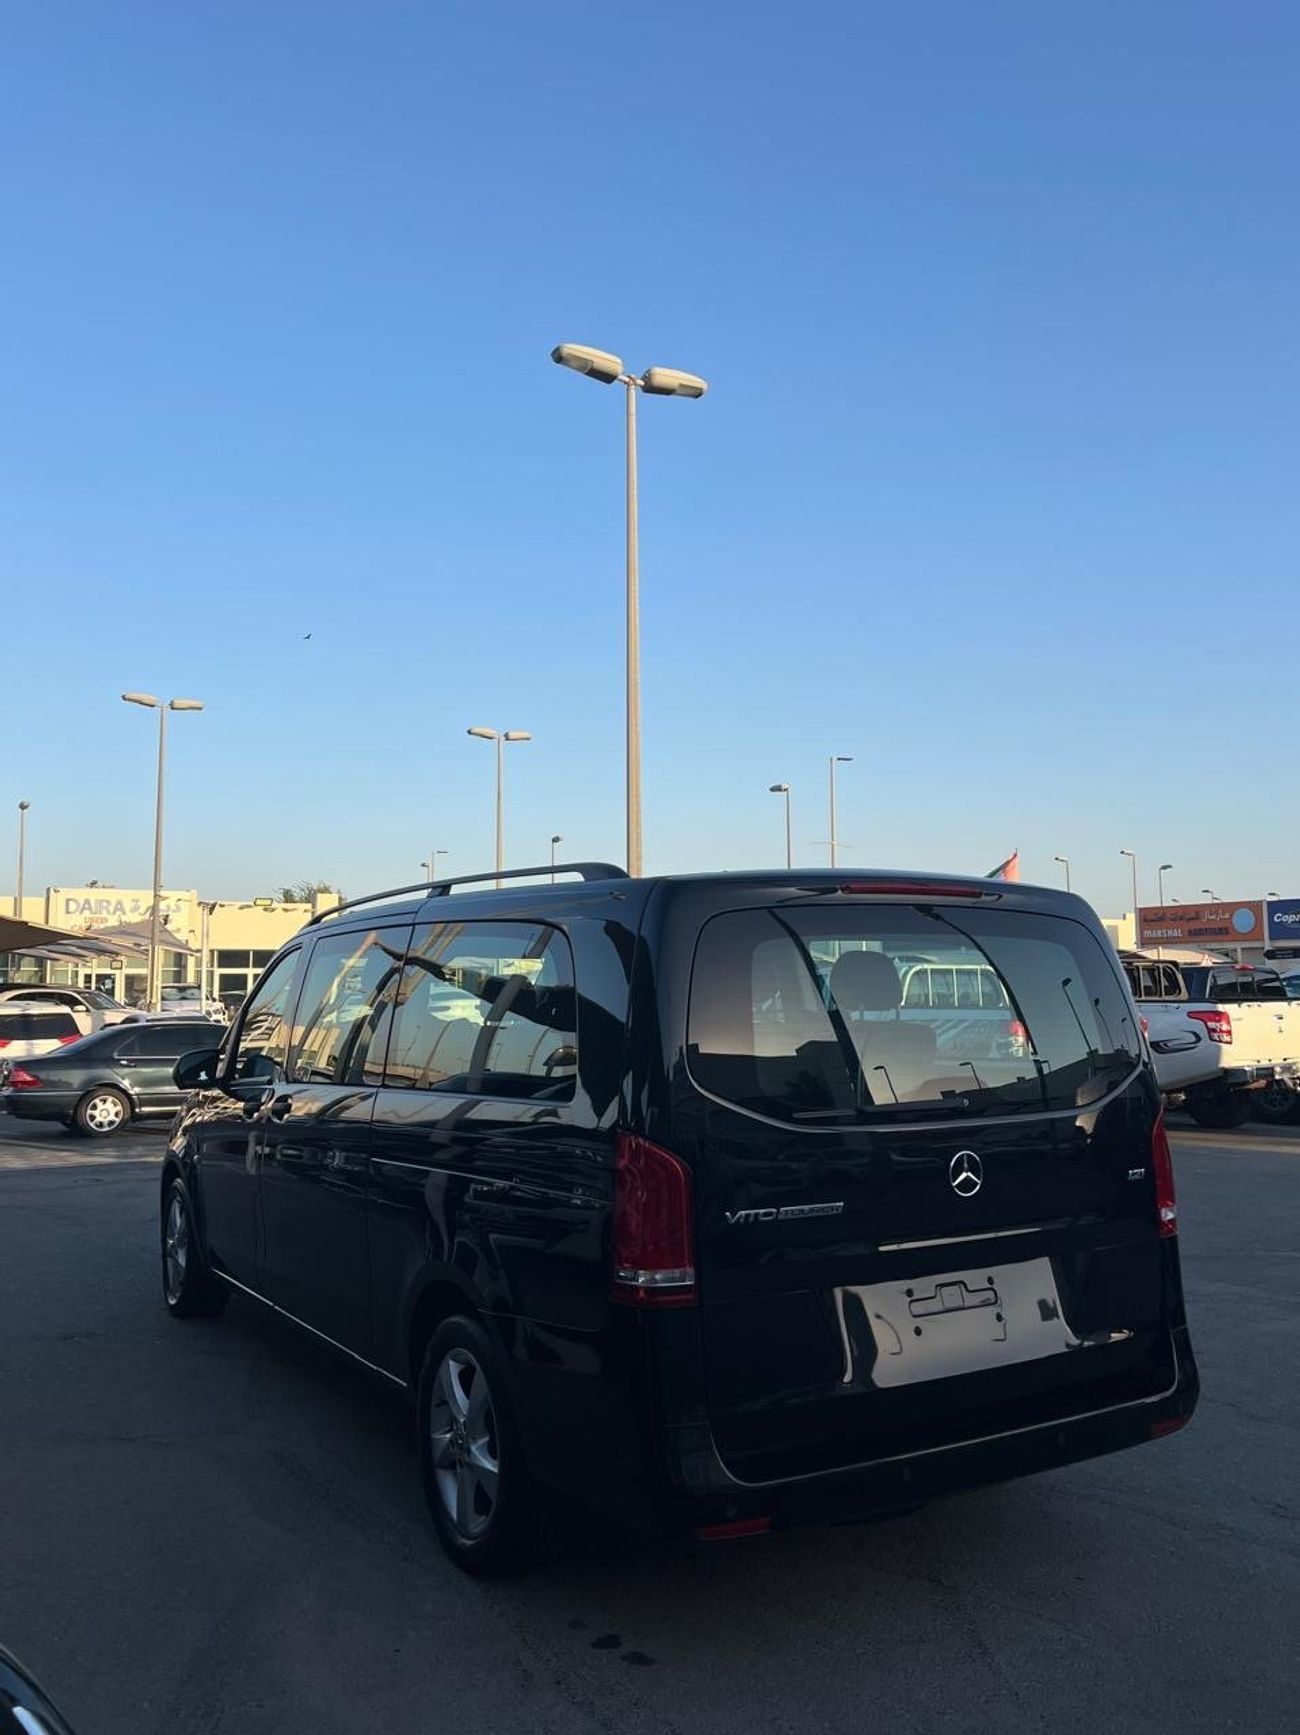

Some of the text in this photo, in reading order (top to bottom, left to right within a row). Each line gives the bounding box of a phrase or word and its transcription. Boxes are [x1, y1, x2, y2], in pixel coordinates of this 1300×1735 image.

[65, 898, 126, 915] DAIRA
[1143, 928, 1183, 938] MARSHAL
[725, 1202, 844, 1224] VITO TOURER
